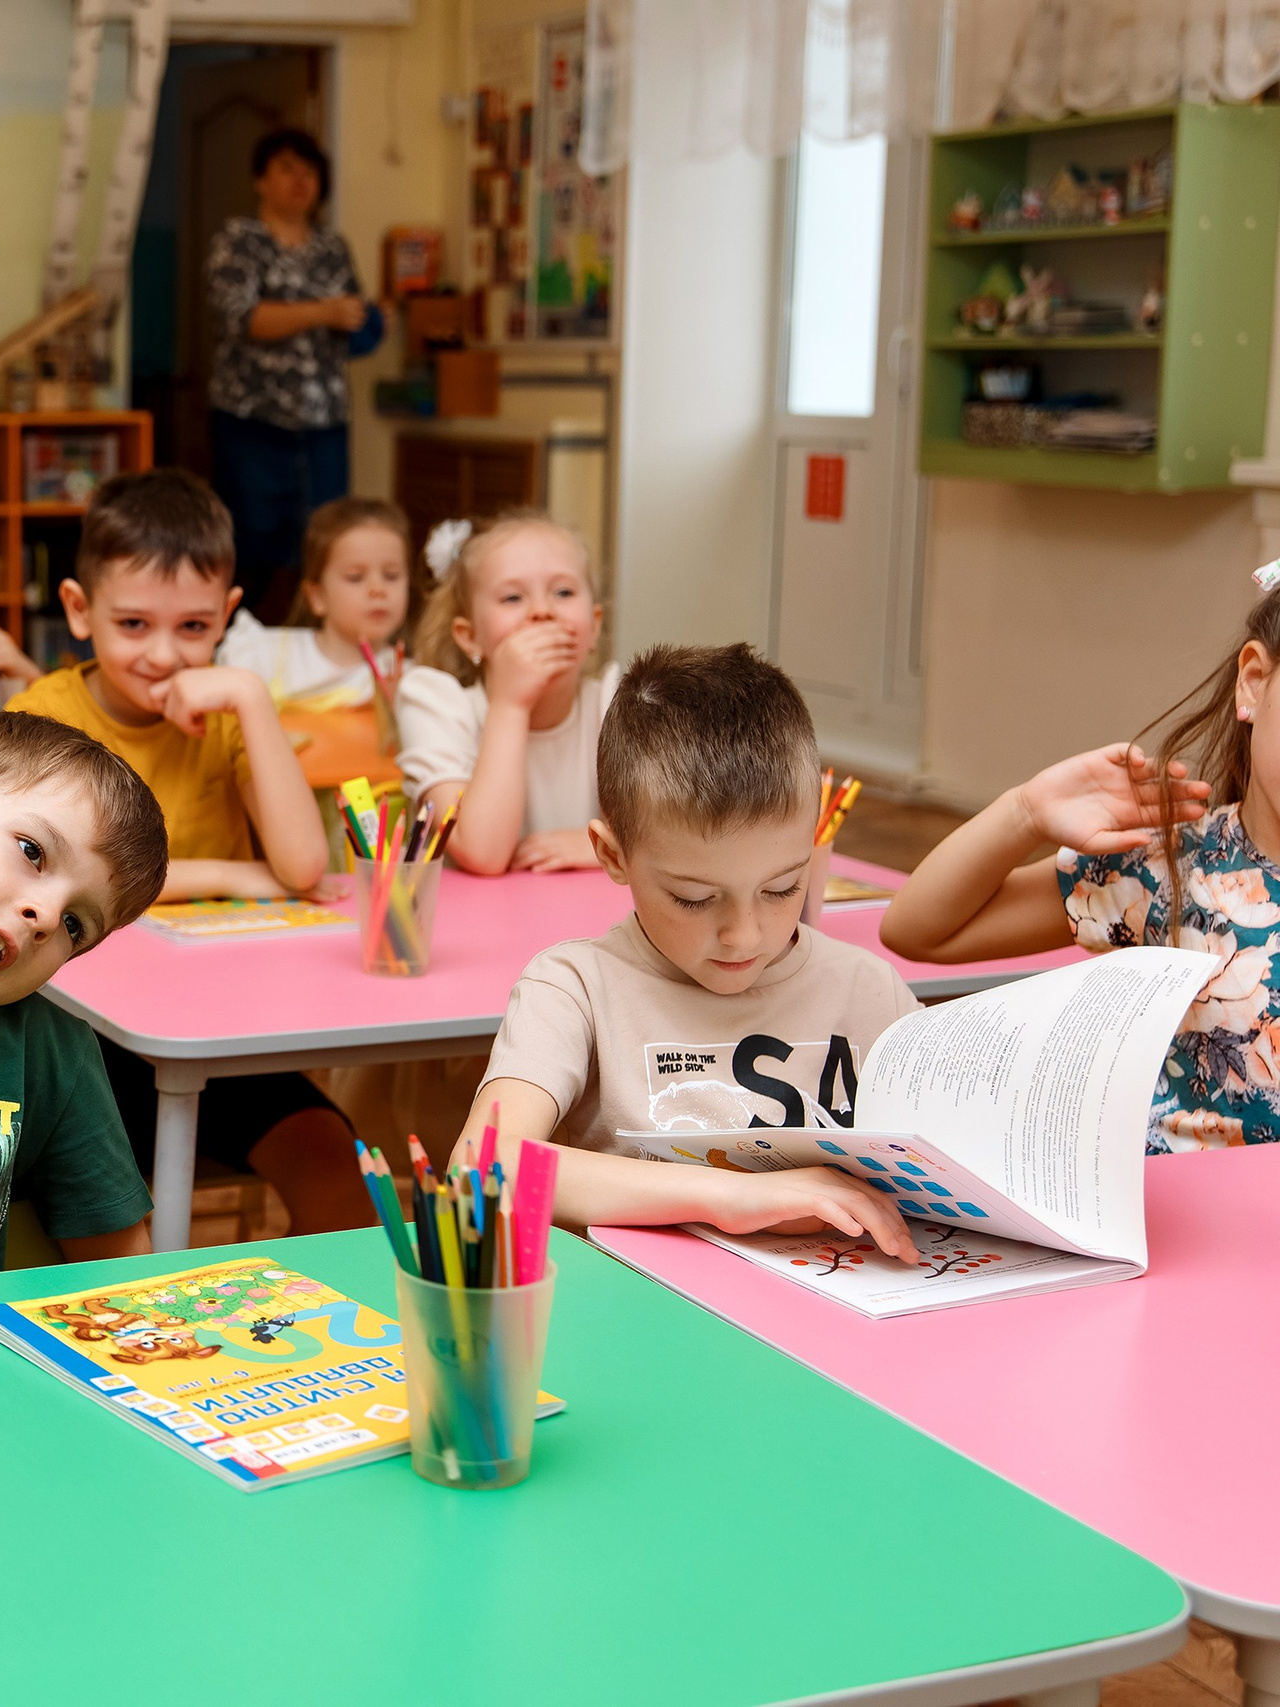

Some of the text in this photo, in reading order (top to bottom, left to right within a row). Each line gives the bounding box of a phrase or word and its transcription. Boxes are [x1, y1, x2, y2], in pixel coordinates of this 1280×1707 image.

[656, 1052, 716, 1063] WALK ON THE
[658, 1063, 706, 1074] WILD SIDE
[192, 1356, 395, 1413] ДВАДЦАТИ
[216, 1378, 377, 1426] СЧИТАЮ
